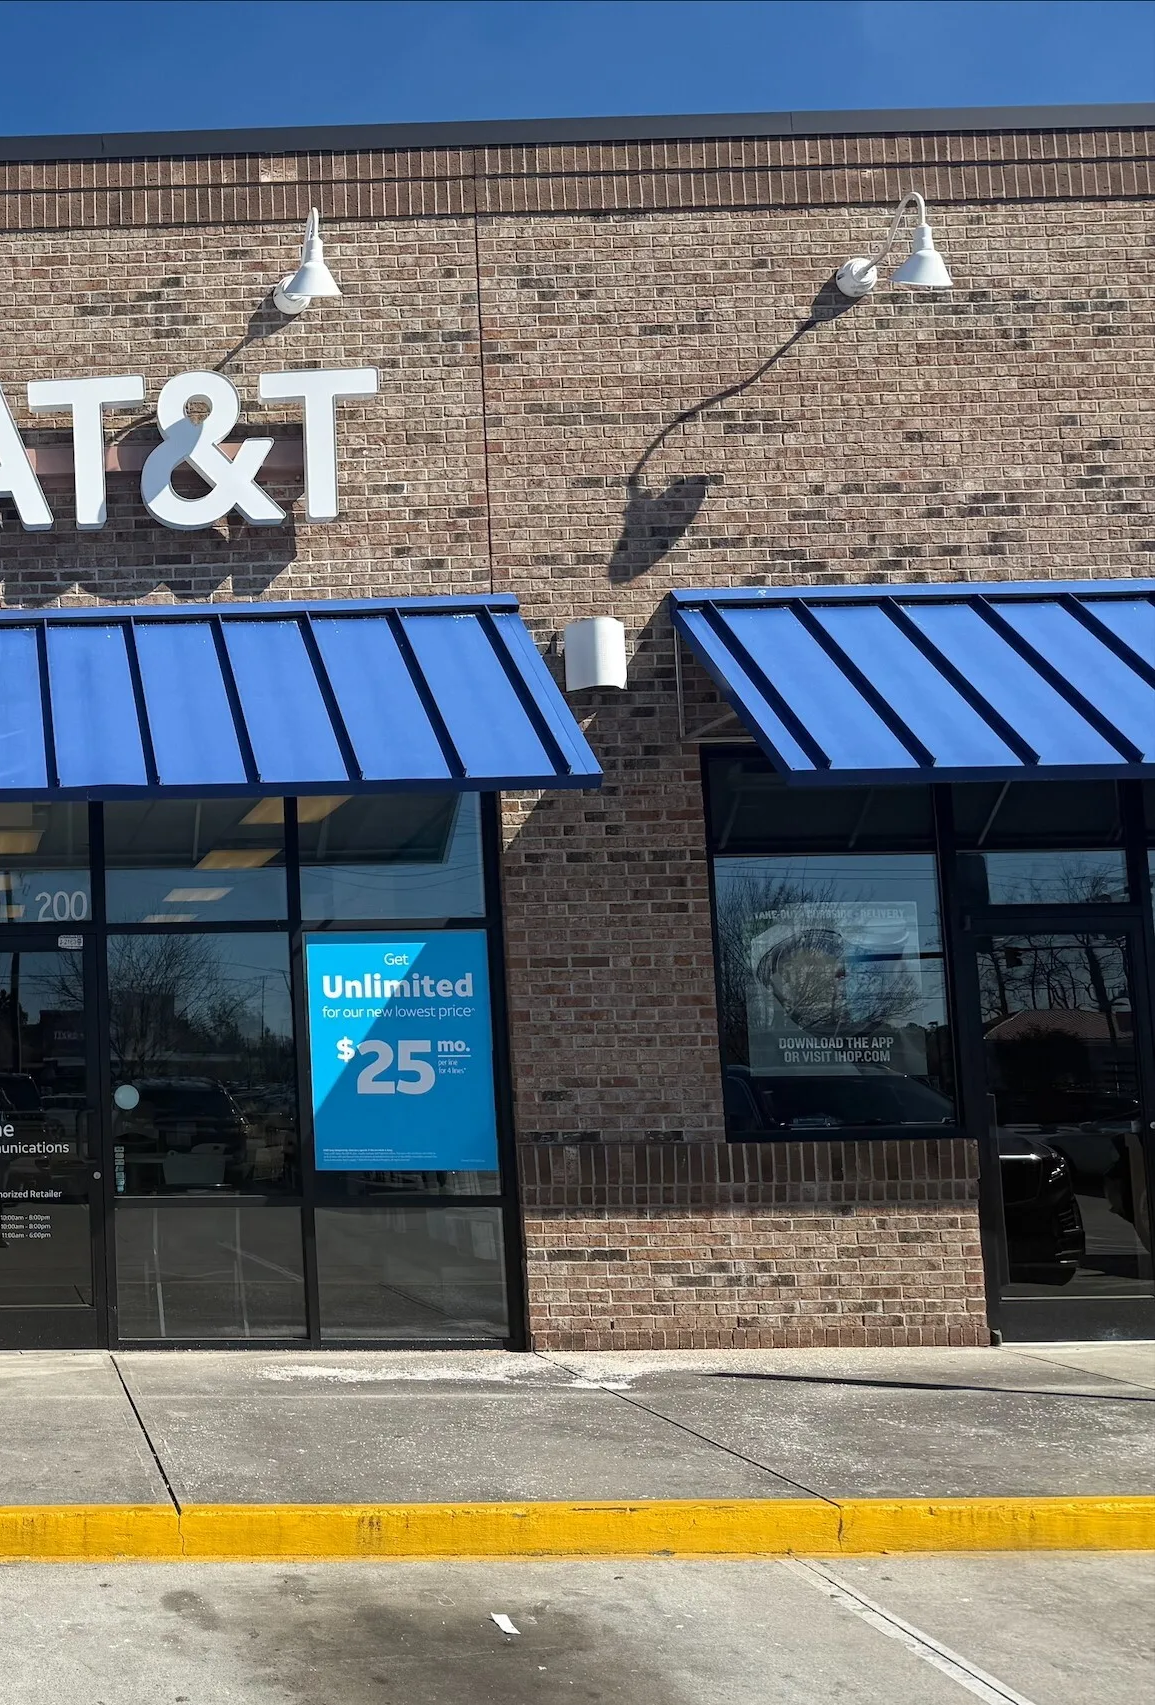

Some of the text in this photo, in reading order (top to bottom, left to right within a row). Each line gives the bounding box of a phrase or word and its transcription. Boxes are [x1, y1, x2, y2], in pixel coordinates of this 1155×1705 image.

[35, 890, 88, 922] 200
[383, 952, 409, 966] Get
[322, 972, 474, 999] Unlimited
[322, 1005, 340, 1018] for
[343, 1008, 364, 1018] our
[366, 1008, 393, 1018] new
[395, 1005, 436, 1018] lowest
[437, 1040, 471, 1052] mo.
[779, 1036, 894, 1049] DOWNLOAD THE APP
[784, 1050, 891, 1063] OR VISIT IHOP.COM
[29, 1189, 63, 1198] Retailer
